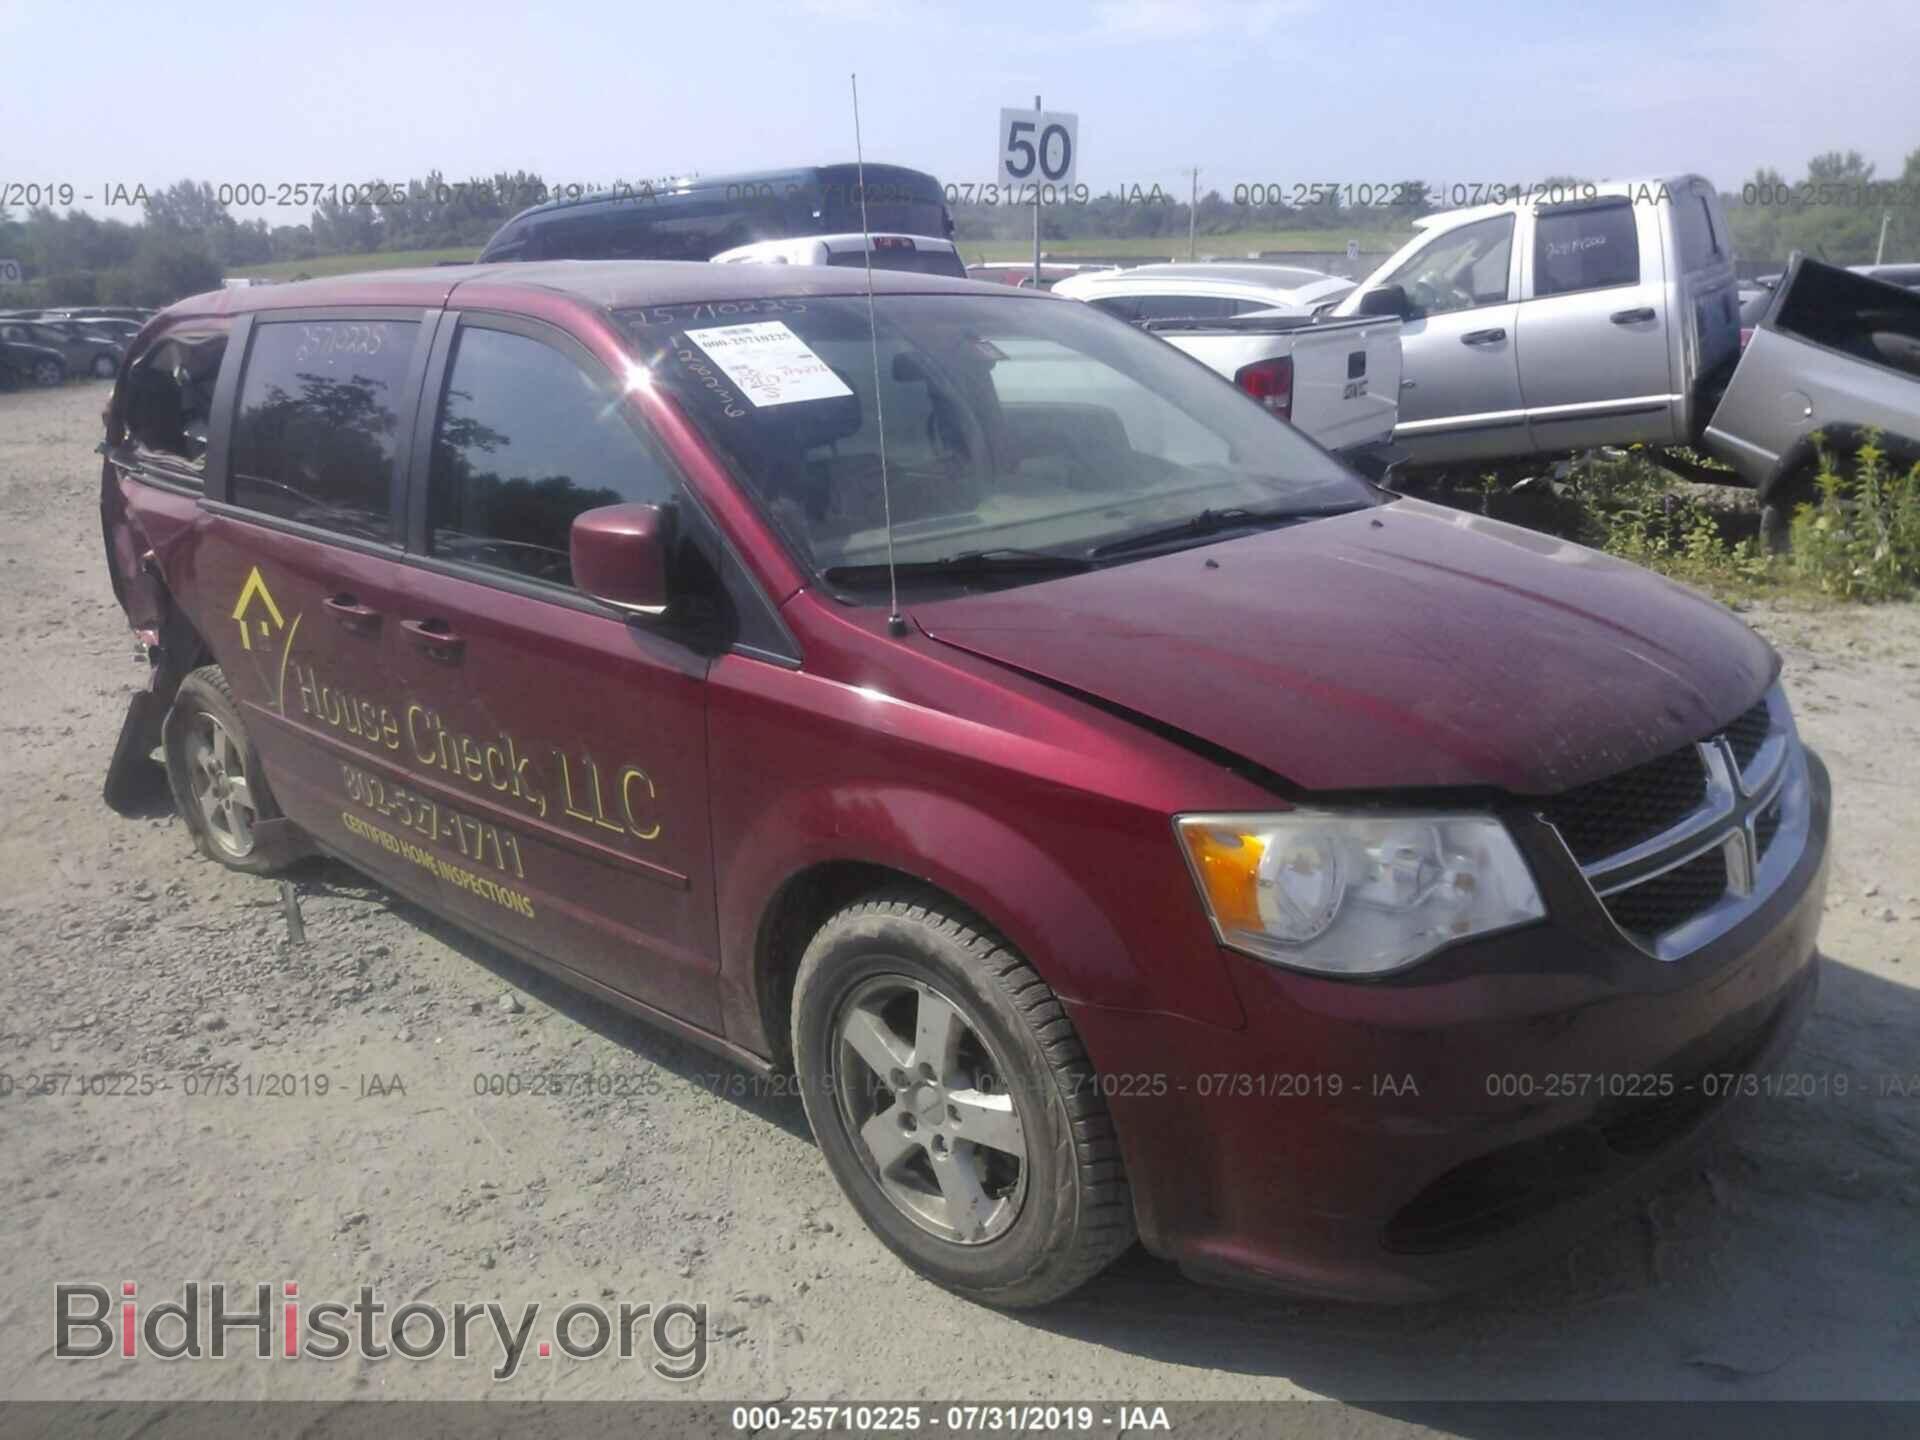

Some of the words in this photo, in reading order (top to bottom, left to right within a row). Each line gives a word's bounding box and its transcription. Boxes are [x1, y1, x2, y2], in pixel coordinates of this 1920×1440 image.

[1005, 121, 1071, 181] 50
[629, 299, 808, 327] 25710225
[294, 662, 400, 749] House
[408, 704, 547, 817] Check,
[552, 747, 661, 840] LLC
[343, 811, 401, 853] CERTIFIED
[399, 838, 440, 876] HOME
[437, 859, 535, 918] INSPECTIONS
